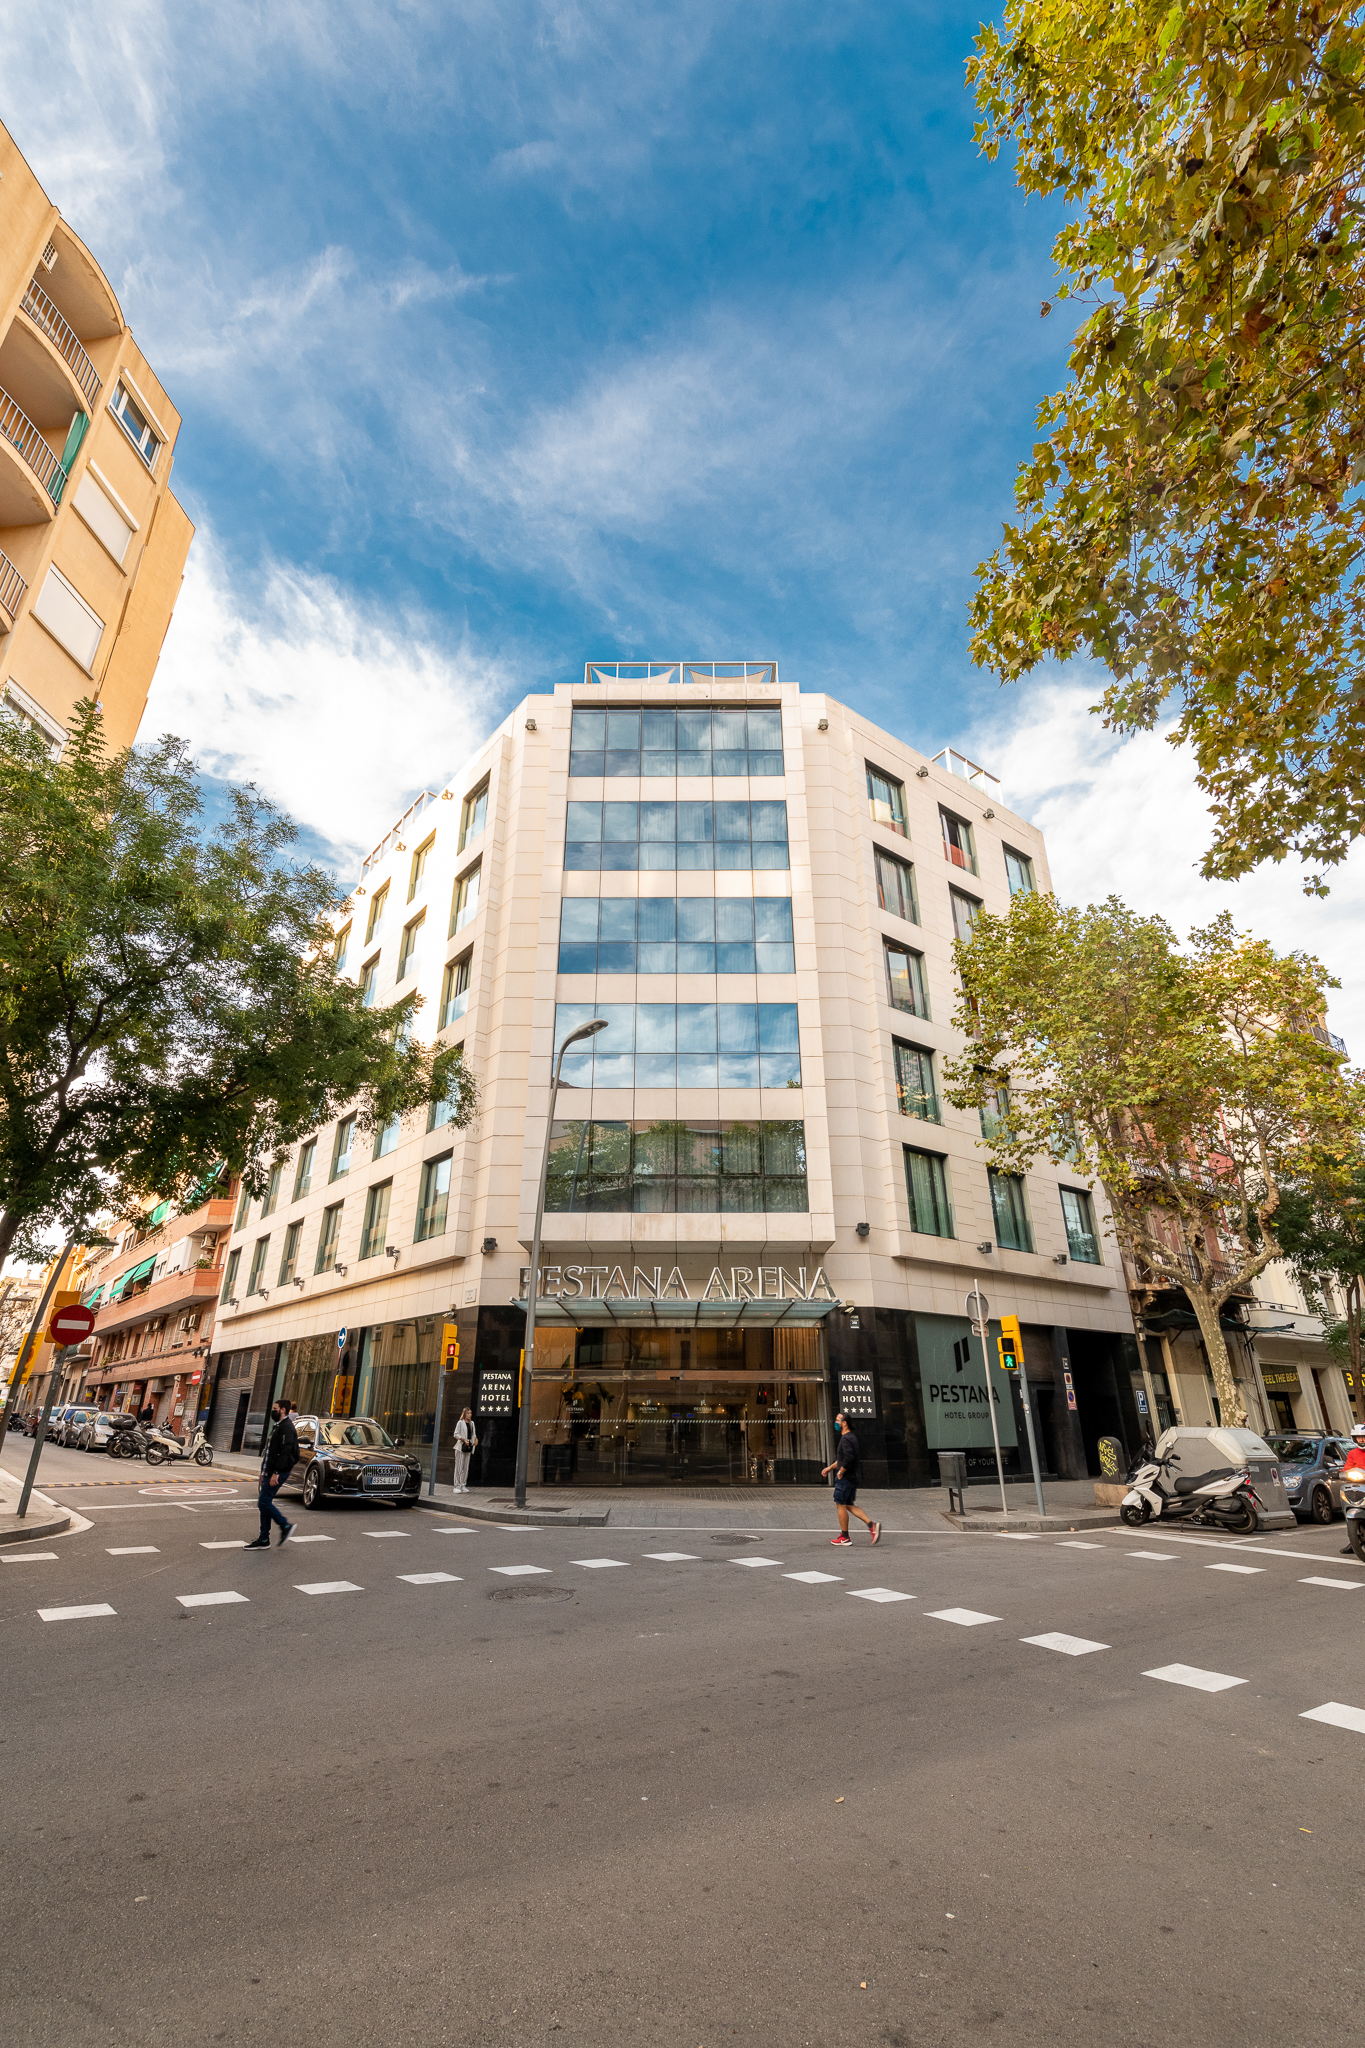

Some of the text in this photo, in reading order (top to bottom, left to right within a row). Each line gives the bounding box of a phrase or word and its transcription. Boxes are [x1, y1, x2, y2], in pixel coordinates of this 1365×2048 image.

[519, 1265, 838, 1300] PESTANA ARENA
[1274, 1373, 1286, 1383] THE
[481, 1383, 511, 1391] ARENA
[481, 1394, 511, 1402] HOTEL
[929, 1384, 1000, 1403] PESTANA
[1138, 1392, 1144, 1405] P
[842, 1395, 873, 1403] HOTEL
[968, 1458, 977, 1467] OF
[977, 1457, 995, 1466] YOUR
